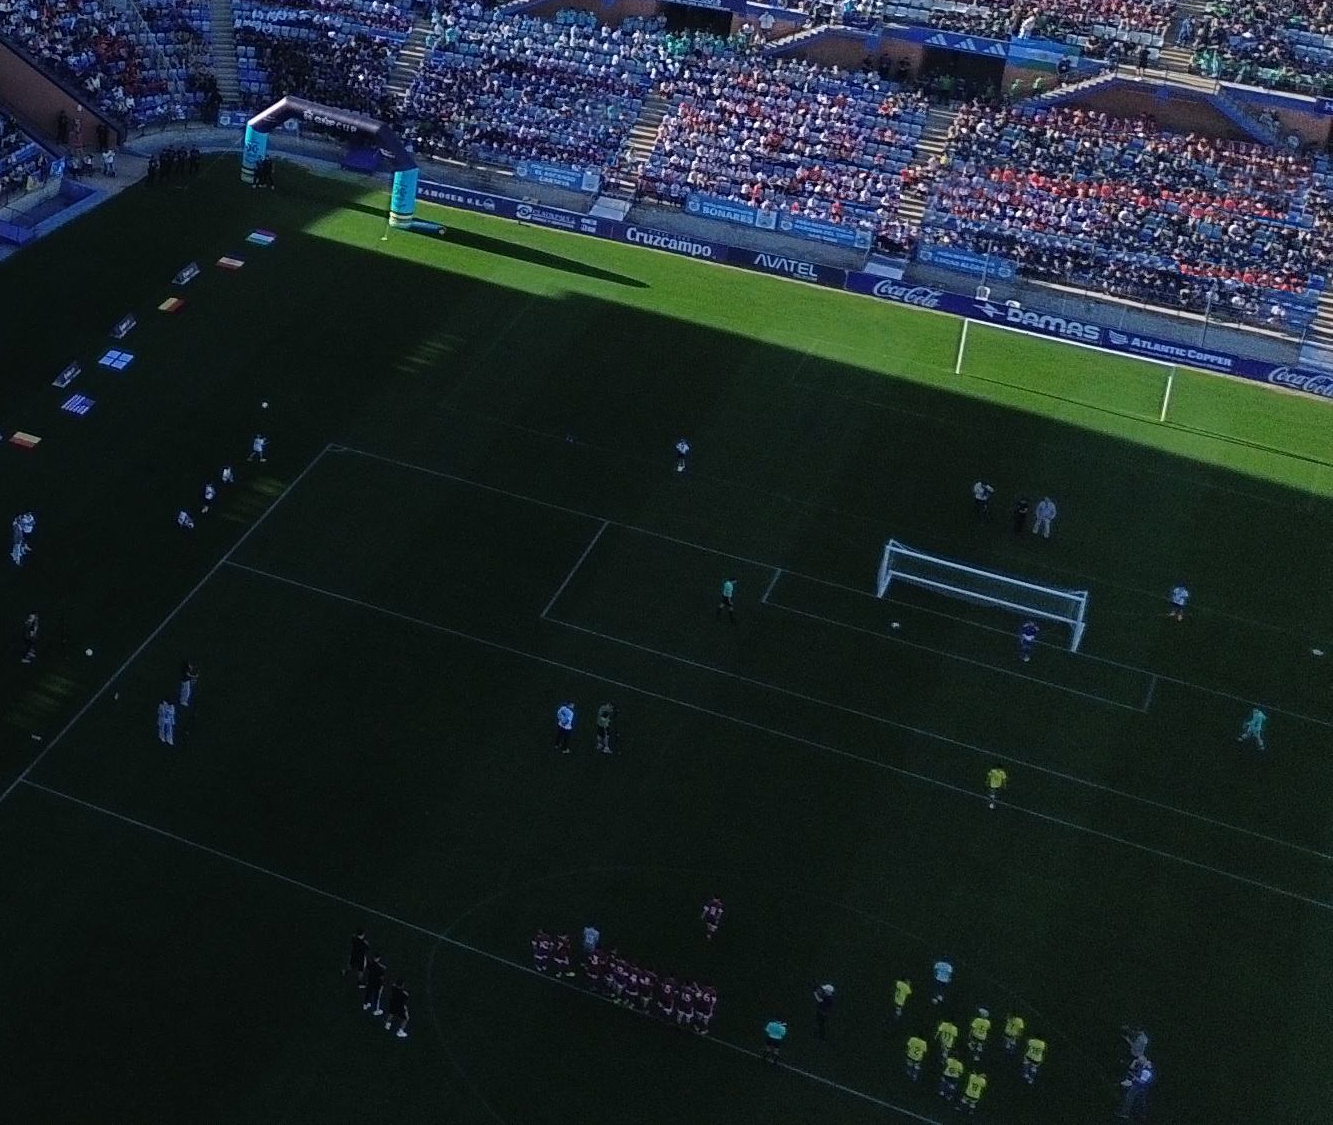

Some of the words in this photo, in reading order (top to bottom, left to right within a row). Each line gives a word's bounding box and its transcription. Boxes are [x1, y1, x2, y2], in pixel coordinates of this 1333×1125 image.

[626, 226, 712, 258] Cruzcampo
[753, 253, 819, 278] AVATEL
[873, 279, 942, 308] Coca-Cola
[1131, 337, 1186, 357] ATLANTIC
[1187, 349, 1232, 366] COPPER
[1268, 366, 1333, 396] Coca-Col
